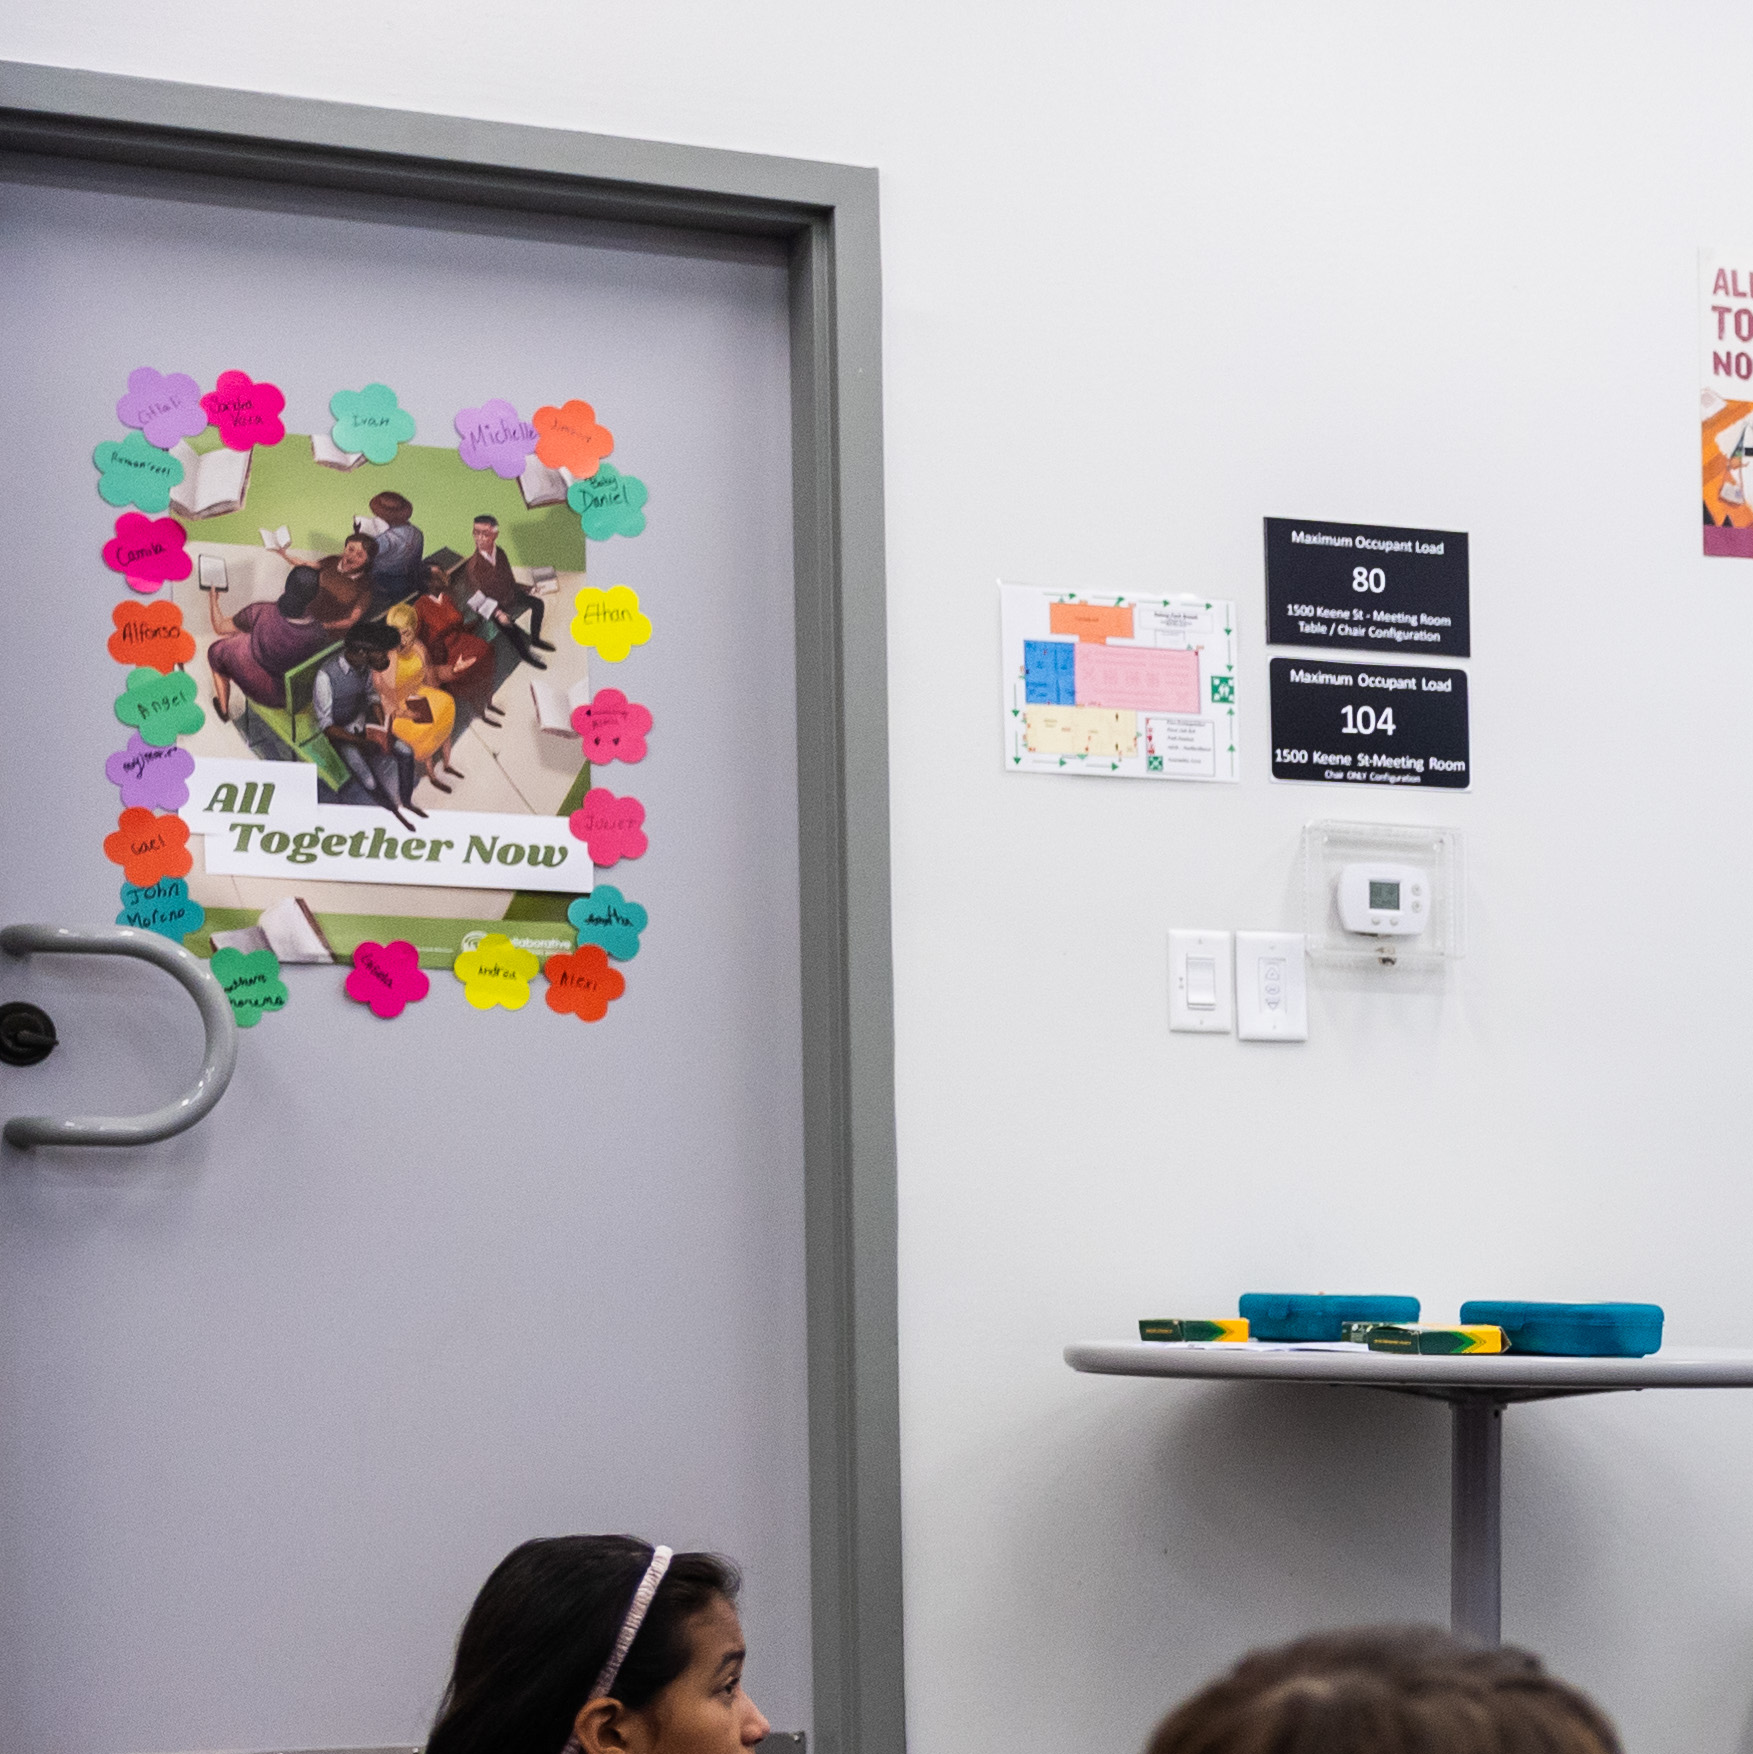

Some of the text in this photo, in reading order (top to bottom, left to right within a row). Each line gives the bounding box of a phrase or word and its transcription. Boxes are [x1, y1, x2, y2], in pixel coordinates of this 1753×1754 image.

[469, 419, 538, 450] Michelle
[579, 485, 631, 513] Daniel
[1291, 530, 1445, 555] Maximum Occupant Load
[1352, 566, 1386, 593] 80
[583, 602, 634, 625] Ethan
[1287, 603, 1315, 618] 1500
[1316, 605, 1350, 620] Keene
[1352, 608, 1364, 621] St
[1373, 610, 1418, 627] Meeting
[1420, 613, 1452, 627] Room
[1298, 620, 1328, 635] Table
[1337, 624, 1366, 638] Chair
[1368, 625, 1441, 643] Configuration
[1290, 669, 1452, 692] Maximum Occupant Load
[137, 691, 186, 720] Angel
[1340, 705, 1396, 736] 104
[1274, 748, 1308, 764] 1500
[1312, 751, 1352, 766] Keene
[1429, 756, 1466, 772] Room
[1324, 769, 1421, 784] Chair ONLY Configuration
[203, 781, 276, 815] All
[229, 822, 568, 868] Together Now
